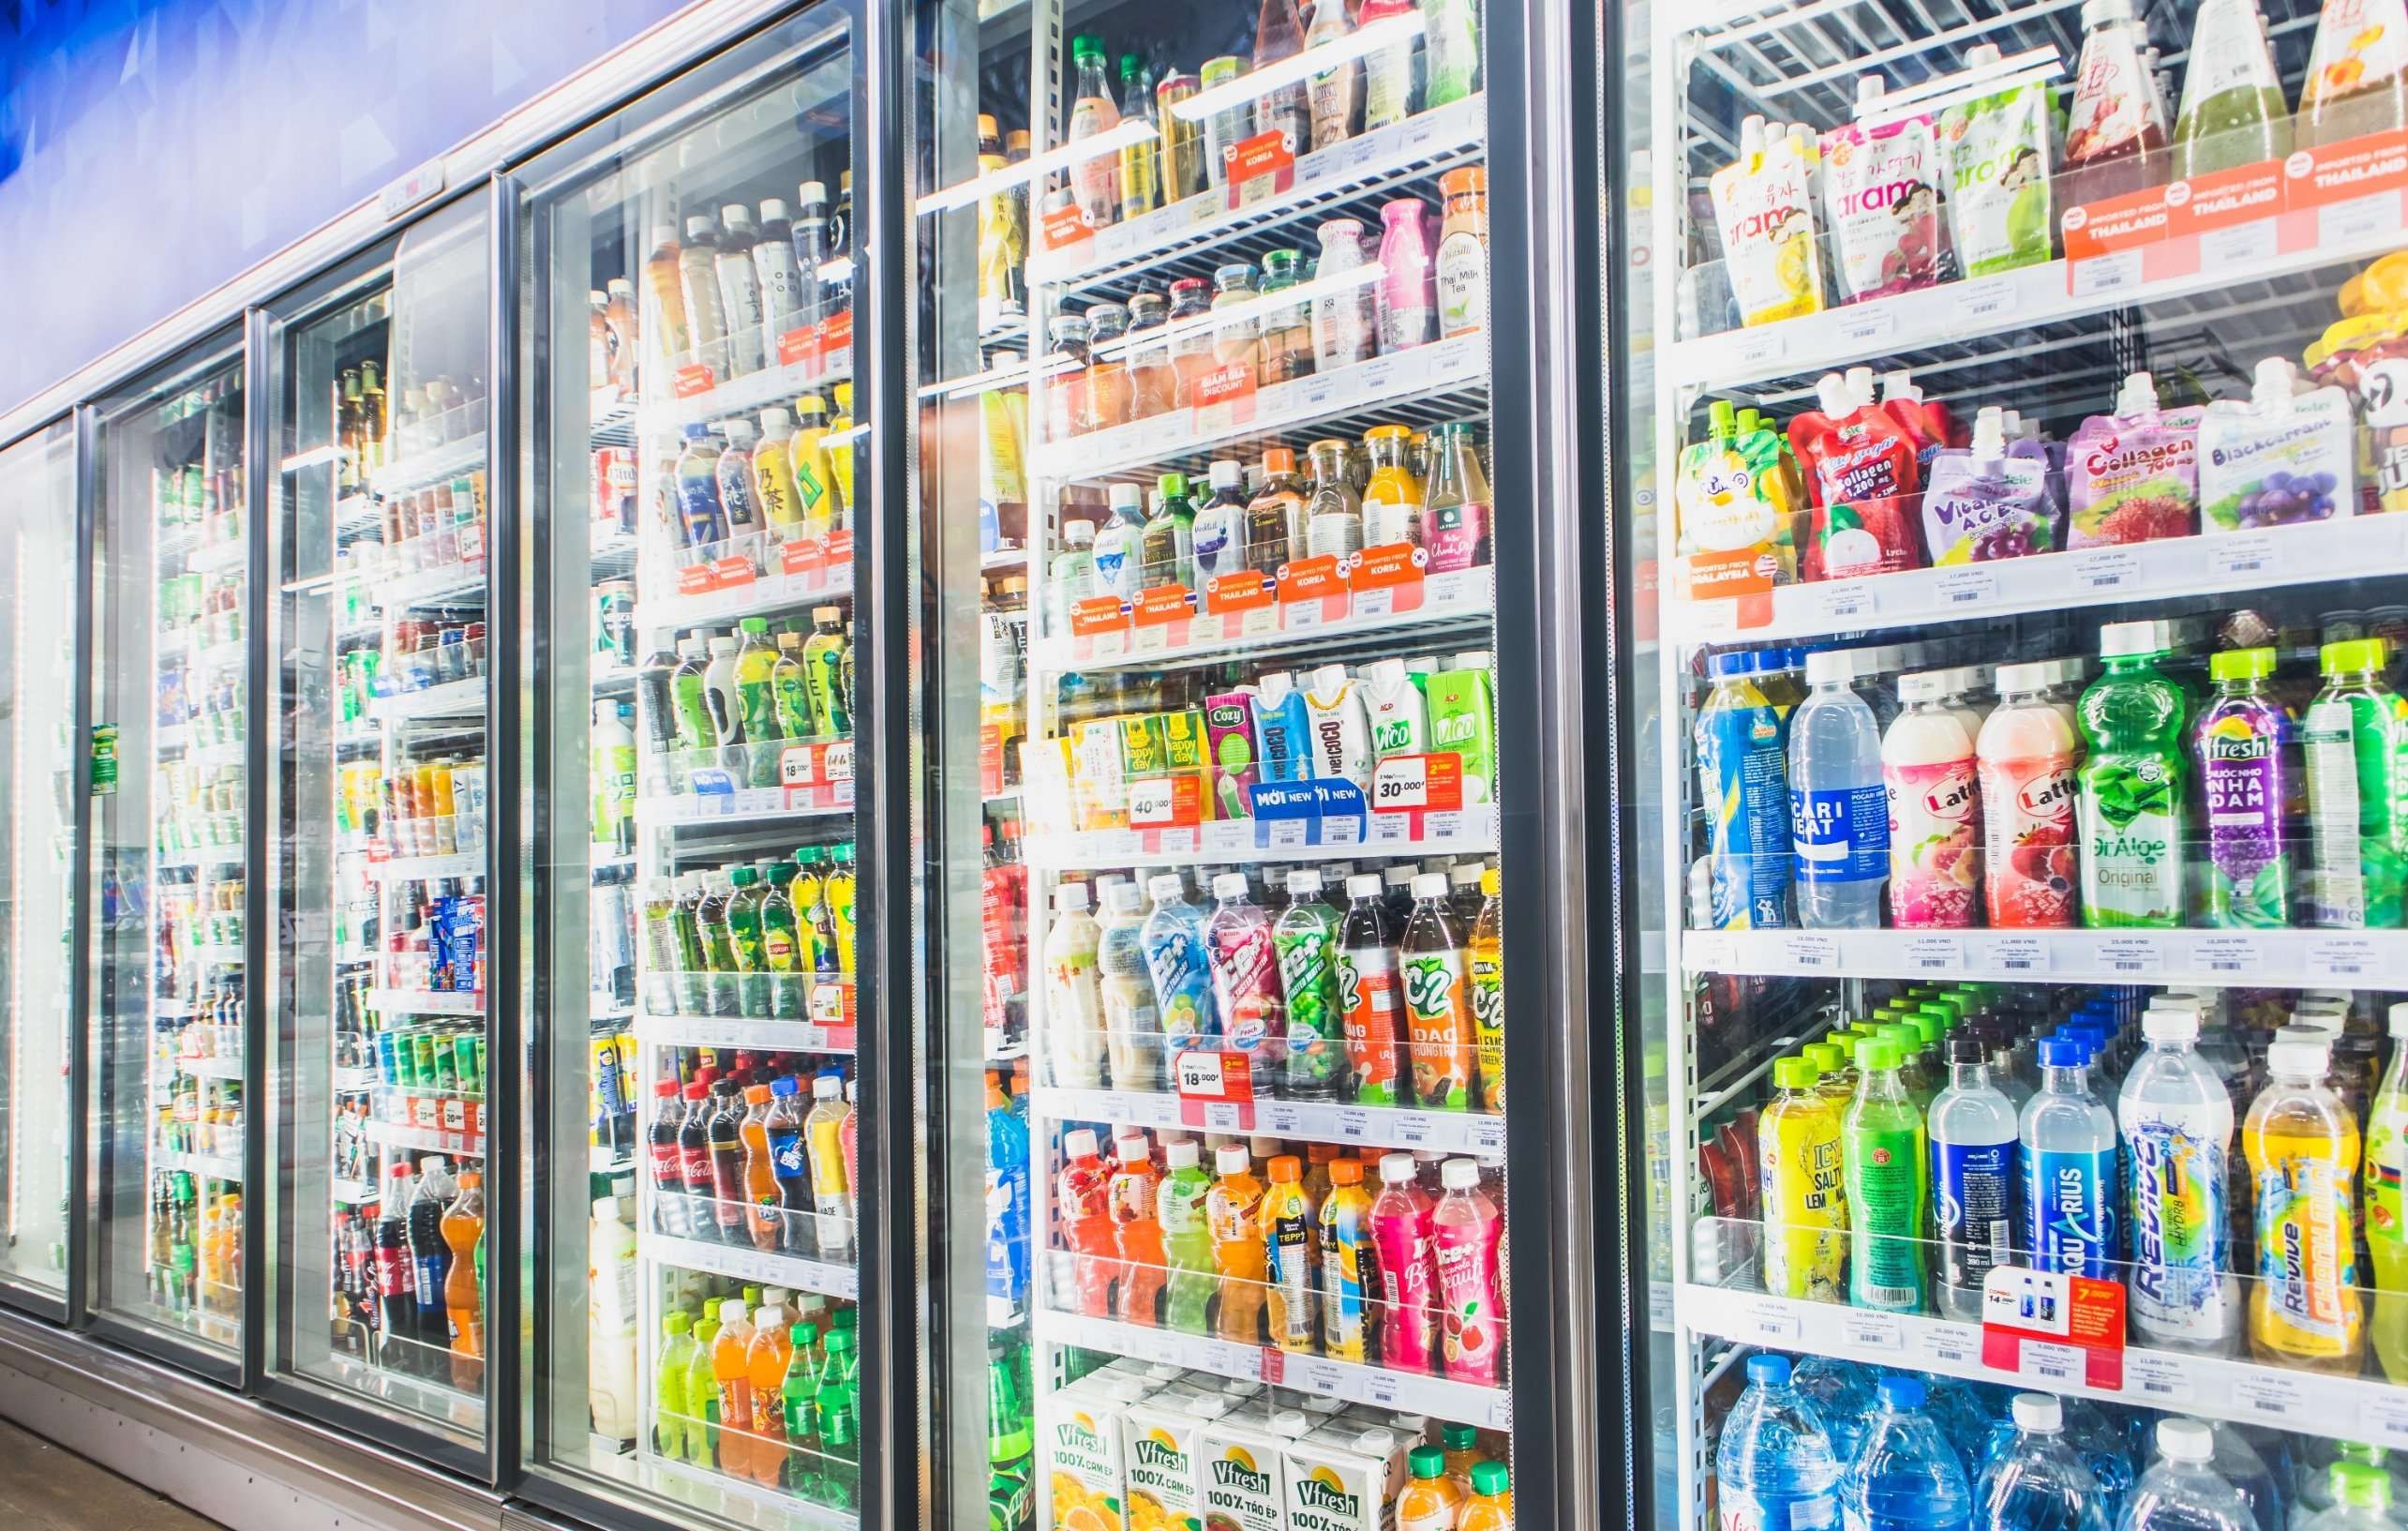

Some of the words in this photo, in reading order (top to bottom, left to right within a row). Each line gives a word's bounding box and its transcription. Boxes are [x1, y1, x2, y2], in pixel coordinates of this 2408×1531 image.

[2314, 157, 2408, 188] THAILAND
[2192, 188, 2279, 218] THAILAND
[2087, 213, 2168, 241] THAILAND
[1203, 379, 1244, 398] DISCOUNT
[2086, 438, 2194, 477] Collagen
[1369, 563, 1402, 576] KOREA
[1691, 567, 1751, 587] MALAYSIA
[1296, 575, 1326, 588] KOREA
[1219, 587, 1259, 601] THAILAND
[1083, 611, 1117, 624] THAILAND
[1145, 601, 1182, 614] THAILAND
[1212, 708, 1242, 724] Cozy
[1132, 756, 1153, 772] day
[1174, 750, 1194, 765] day
[1331, 788, 1357, 801] NEW
[2209, 776, 2264, 793] NHA
[1288, 791, 1313, 803] NEW
[1790, 801, 1843, 819] CARI
[2098, 868, 2159, 888] Original
[1405, 965, 1452, 1014] C2
[1814, 1166, 1844, 1192] SALTY
[2283, 1221, 2304, 1314] Revive
[1054, 1449, 1085, 1469] 100%
[1085, 1459, 1104, 1474] CAM
[1135, 1439, 1189, 1475] Vfresh
[1130, 1468, 1165, 1488] 100%
[1165, 1478, 1185, 1494] CAM
[1212, 1460, 1271, 1495] Vfresh
[1207, 1490, 1245, 1510] 100%
[1245, 1497, 1264, 1517] TÁO
[1265, 1503, 1279, 1520] ÉP
[1297, 1478, 1359, 1518] Vfresh
[1291, 1511, 1330, 1531] 100%
